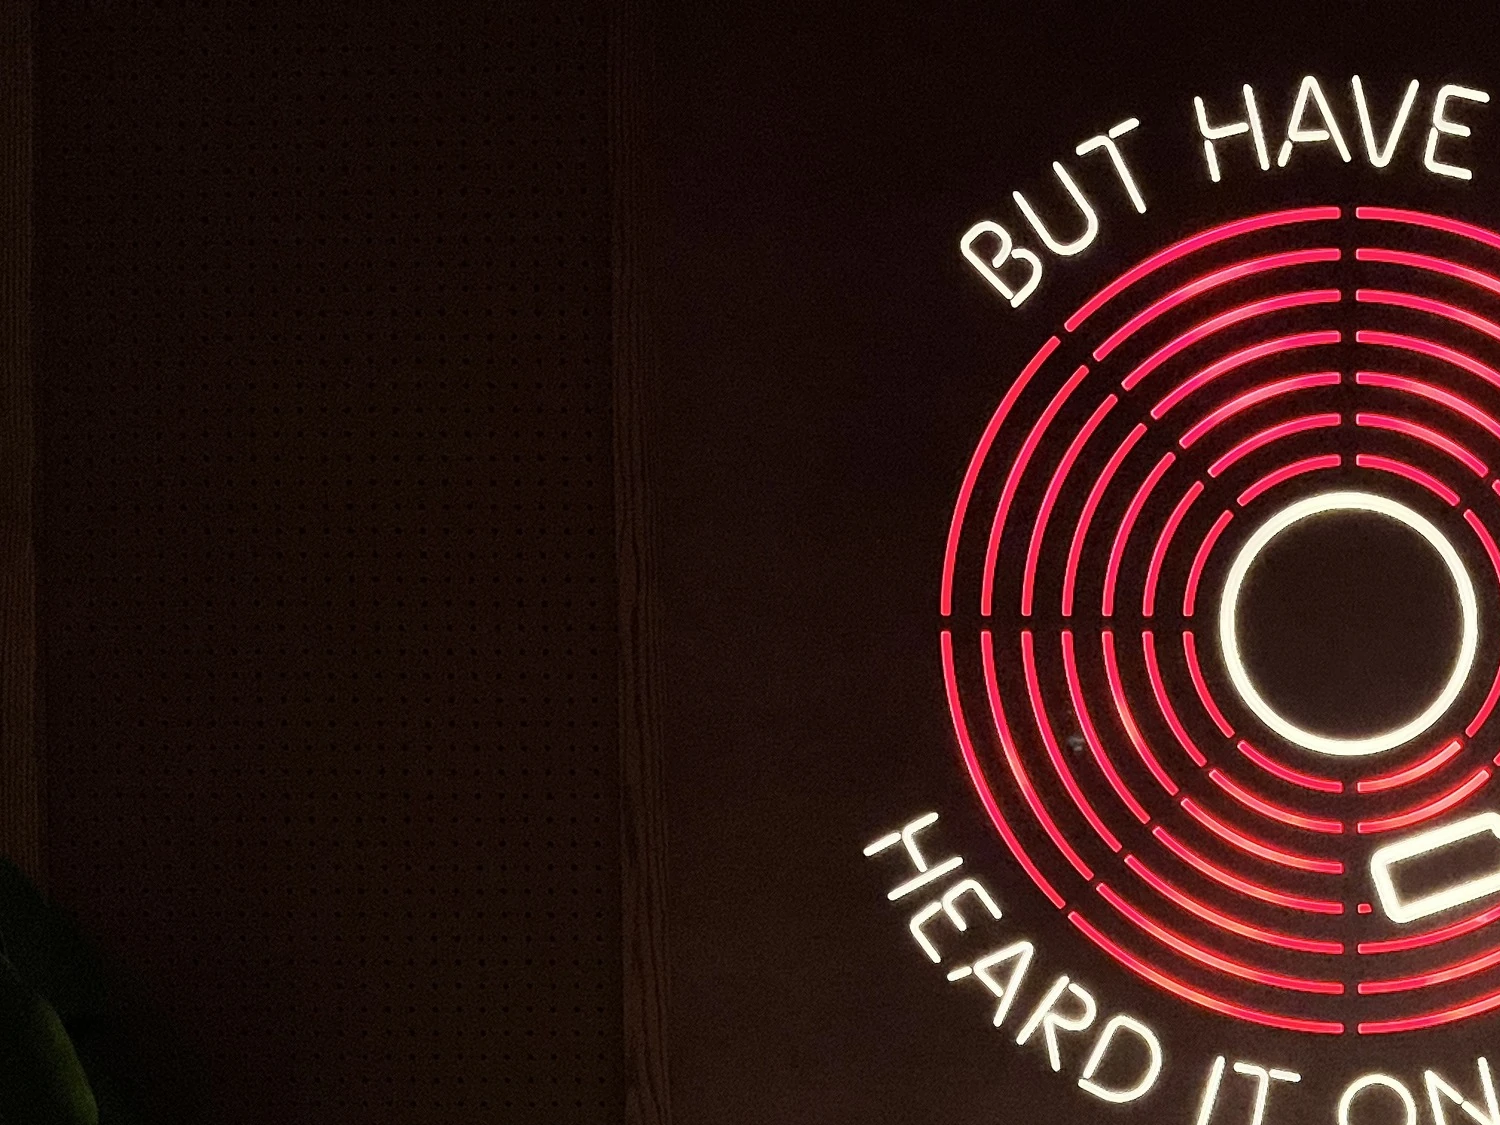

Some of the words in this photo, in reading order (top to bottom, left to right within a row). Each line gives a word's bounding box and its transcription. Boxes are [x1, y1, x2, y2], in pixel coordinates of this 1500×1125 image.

[959, 118, 1147, 309] BUT
[1194, 74, 1490, 183] HAVE
[863, 811, 1163, 1104] HEARD
